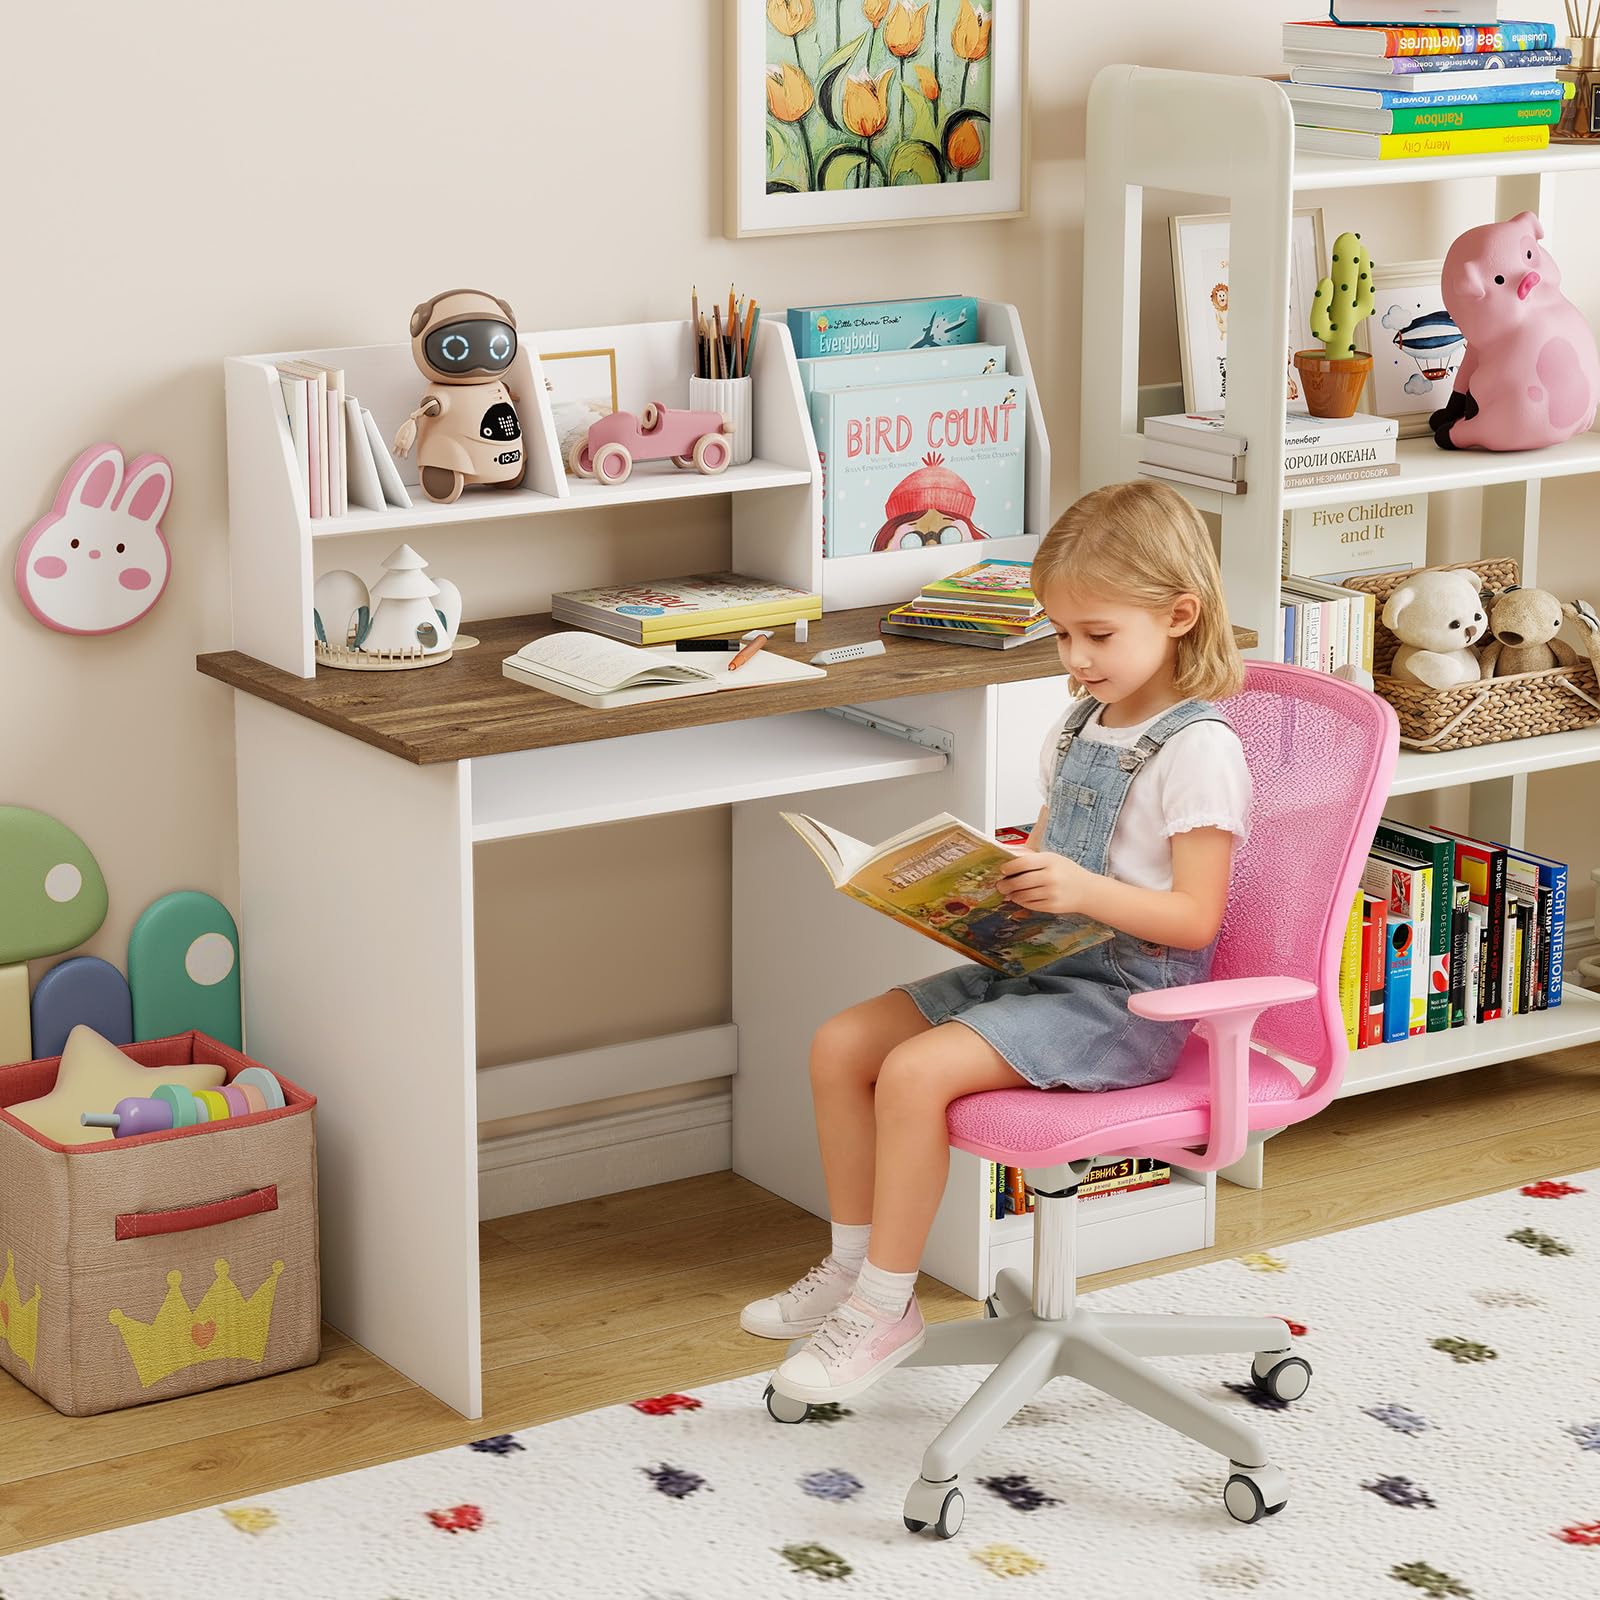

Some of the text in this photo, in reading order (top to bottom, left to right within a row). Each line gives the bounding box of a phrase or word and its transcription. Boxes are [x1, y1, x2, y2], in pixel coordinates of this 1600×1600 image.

[1400, 33, 1503, 50] Sea adventures
[1392, 94, 1477, 104] World of flowers
[1530, 88, 1561, 97] Sydney
[1415, 112, 1463, 126] Rainbow
[1517, 108, 1551, 118] Columbia
[1402, 139, 1450, 152] Merry City
[820, 331, 880, 355] Everybody
[927, 403, 1017, 449] COUNT
[1330, 448, 1376, 464] ОКЕАНА
[1316, 471, 1359, 484] НЕЗРИМОГО
[1361, 468, 1388, 479] СОБОРА
[1312, 502, 1413, 527] Five Children
[1340, 525, 1385, 544] and It
[1311, 606, 1320, 645] Elliott
[1394, 834, 1405, 844] THE
[1495, 872, 1503, 890] best
[1545, 890, 1553, 934] TRUMP
[1350, 911, 1359, 958] BUSINESS
[1440, 913, 1448, 953] DESIGN
[1551, 871, 1566, 993] YACHT INTERIORS
[1350, 958, 1358, 980] SIDE
[1452, 933, 1464, 990] PREDATOR
[1081, 1165, 1118, 1183] НЕВНИК
[1119, 1162, 1129, 1176] 3
